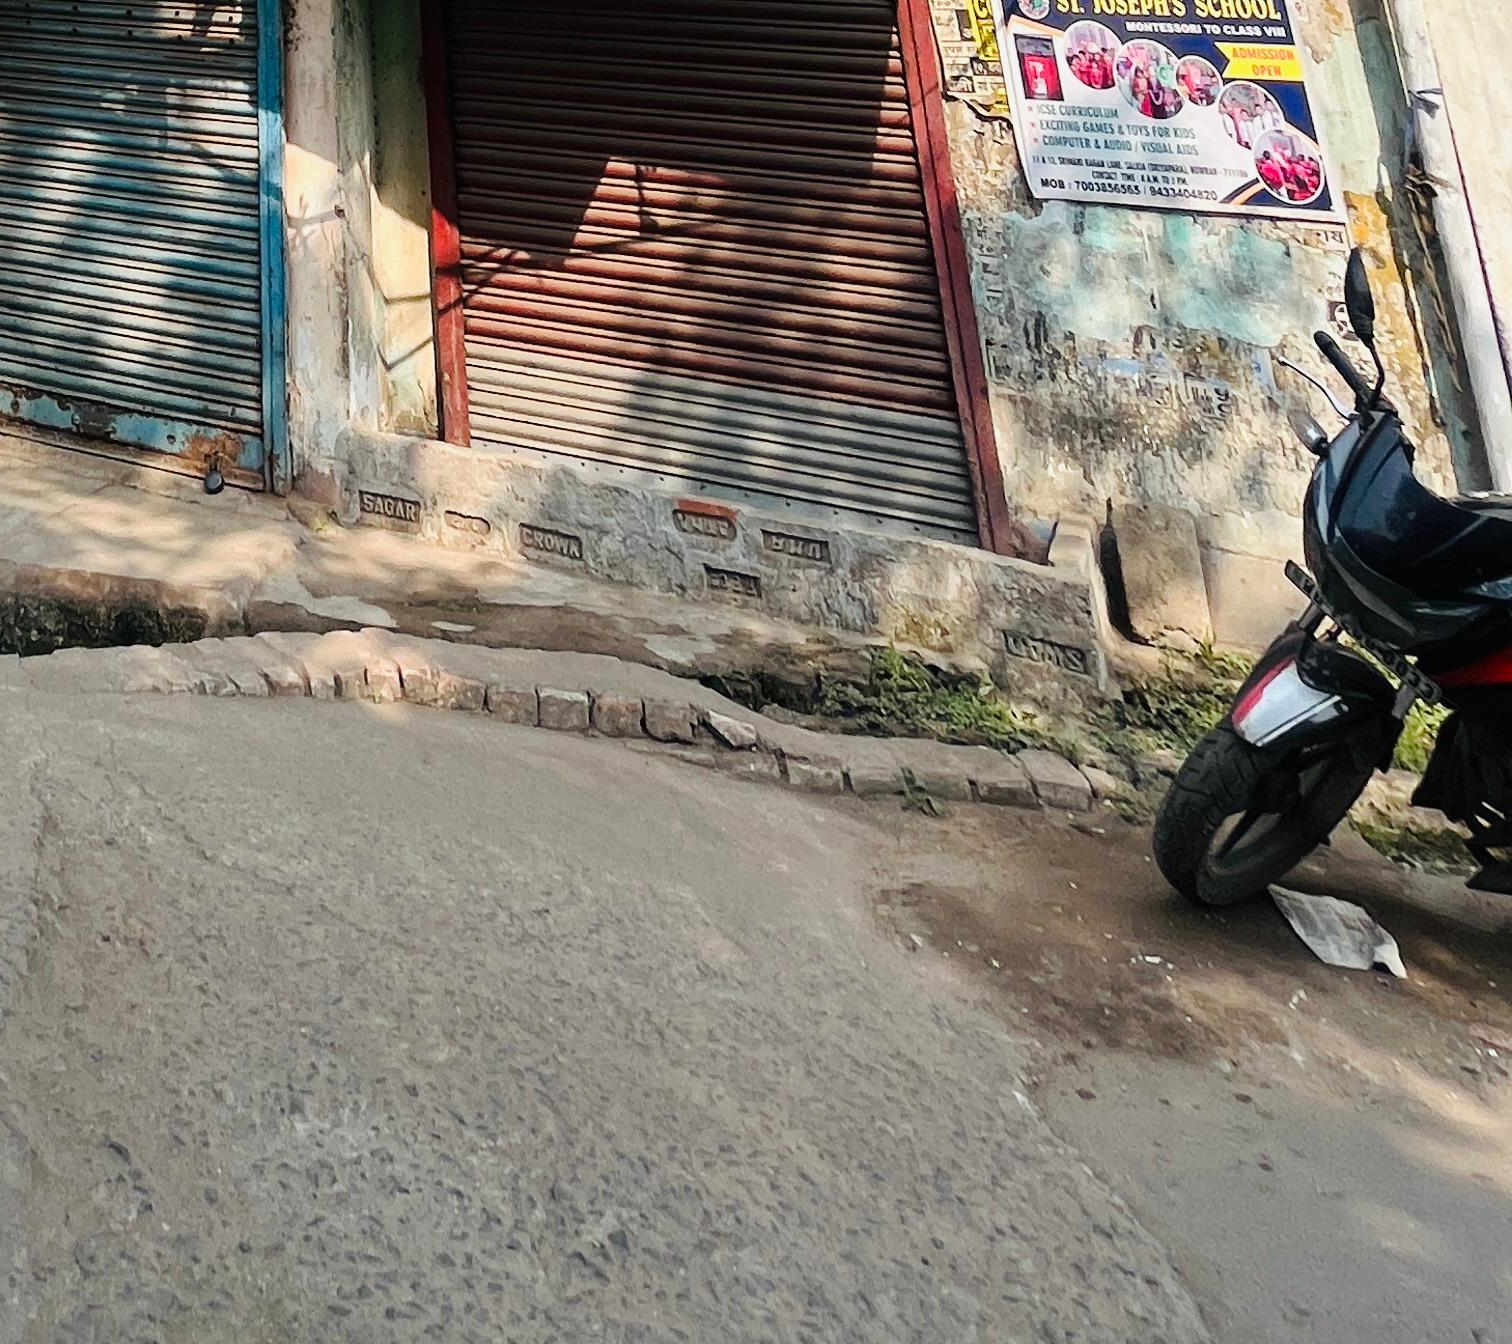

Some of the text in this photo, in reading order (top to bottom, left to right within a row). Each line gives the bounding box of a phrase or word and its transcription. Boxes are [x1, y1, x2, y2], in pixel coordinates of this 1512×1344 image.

[1125, 21, 1287, 38] MONTESSORI TO CLASS VIII
[1232, 47, 1295, 61] ADMISSION
[1251, 64, 1282, 77] OPEN
[1059, 105, 1119, 119] CURRICULUM
[1040, 119, 1081, 133] EXCITING
[1082, 121, 1115, 135] GAMES
[1127, 124, 1150, 137] TOYS
[1152, 126, 1171, 138] FOR
[1173, 127, 1196, 139] KIDS
[1042, 135, 1091, 149] COMPUTER
[1104, 139, 1133, 151] AUDIO
[1140, 141, 1173, 154] VISUAL
[1176, 144, 1199, 156] AIDS
[1040, 177, 1065, 190] MOB
[362, 493, 417, 522] SAGAR
[521, 526, 582, 560] CROWN
